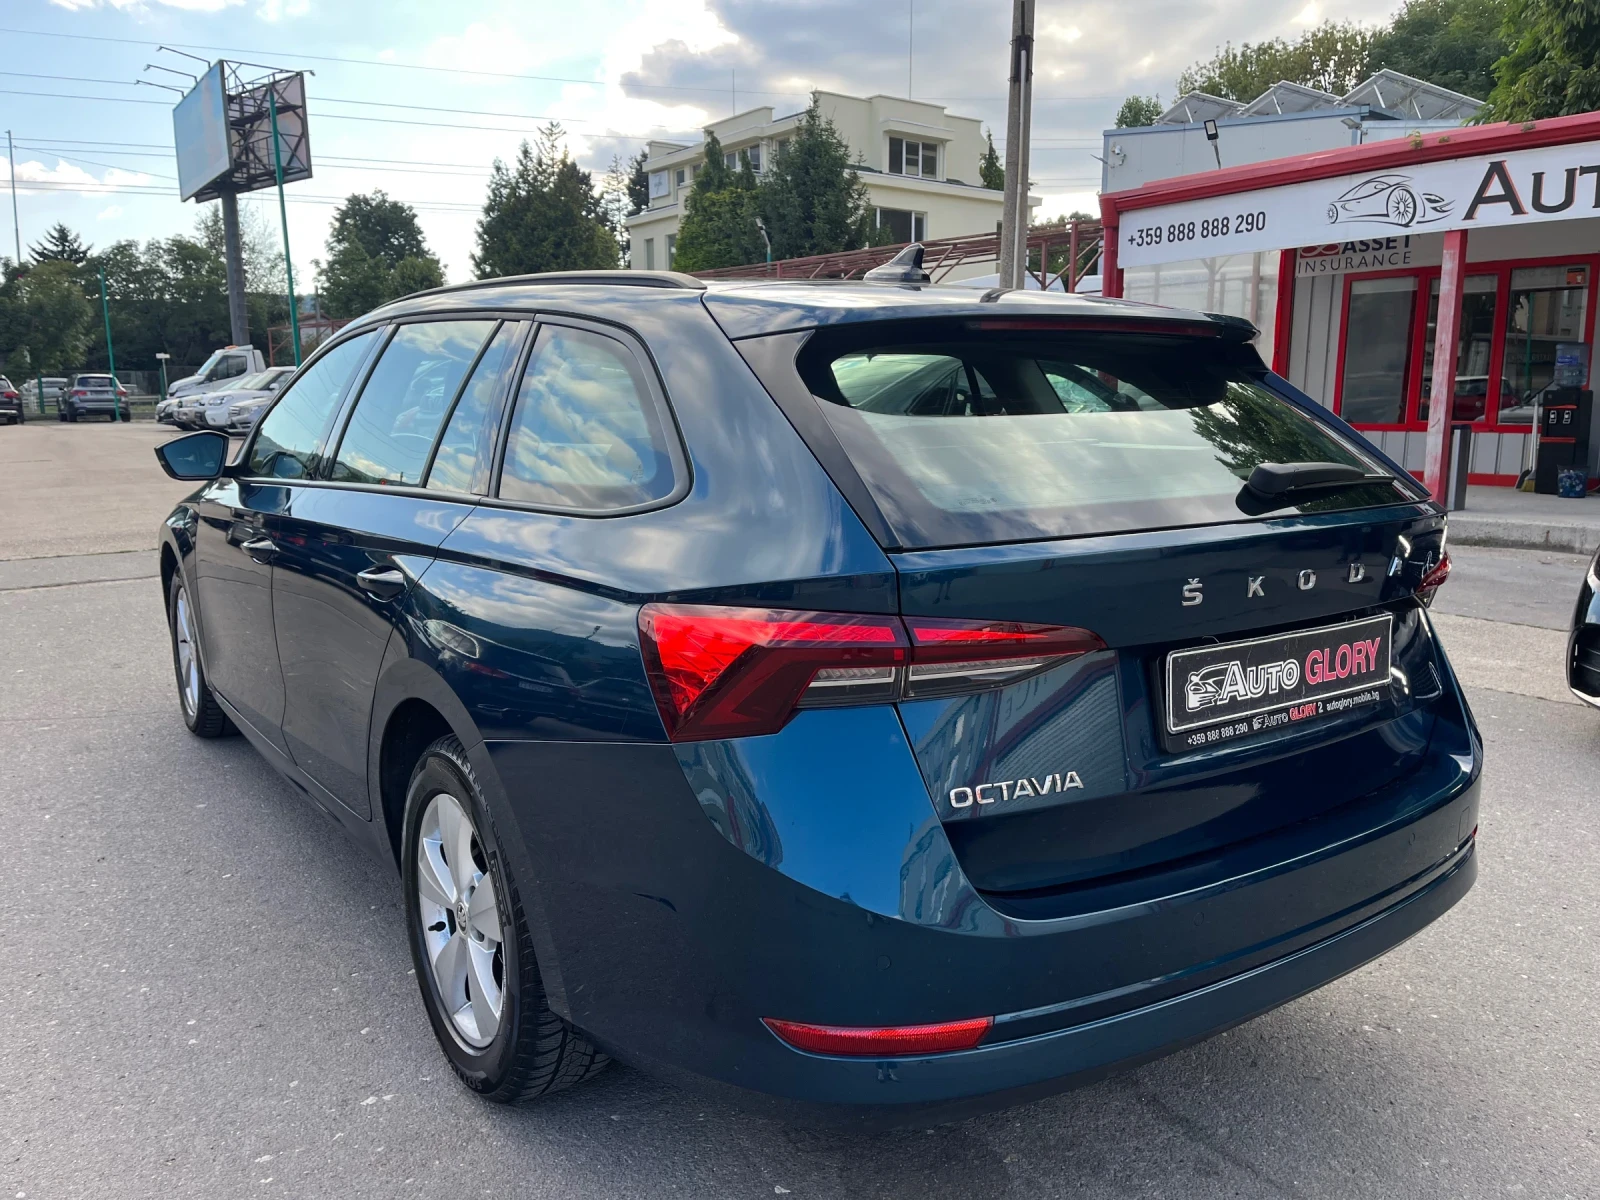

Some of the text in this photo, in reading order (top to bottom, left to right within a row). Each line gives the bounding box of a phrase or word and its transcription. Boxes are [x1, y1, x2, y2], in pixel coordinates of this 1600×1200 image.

[1128, 211, 1267, 247] +359 888 888 290
[1298, 251, 1412, 274] INSURANCE
[1217, 637, 1381, 705] AUTO GLORY
[1187, 690, 1380, 745] +359 888 888 290 AUTO GLORY 2 autoglory.mobile.bg
[949, 770, 1085, 809] OCTAVIA
